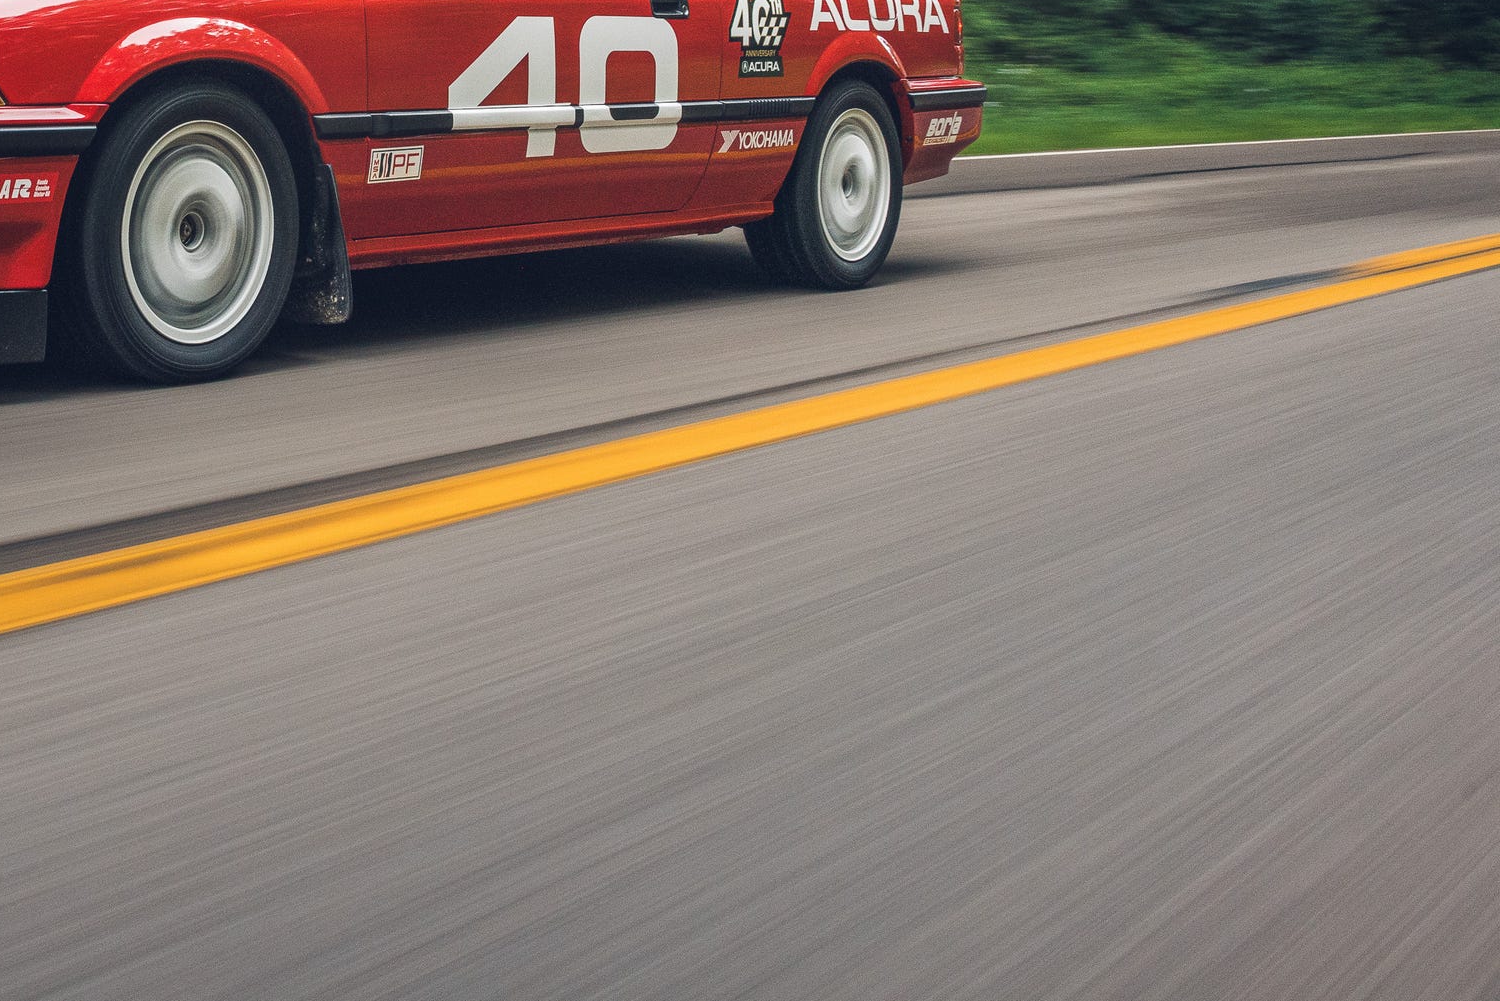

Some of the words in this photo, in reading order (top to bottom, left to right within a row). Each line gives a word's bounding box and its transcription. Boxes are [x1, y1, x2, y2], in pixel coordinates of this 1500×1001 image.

[748, 61, 780, 72] ACURA
[448, 15, 682, 158] 40
[738, 129, 794, 150] YOKOHAMA
[392, 153, 419, 175] PF
[11, 178, 32, 199] R
